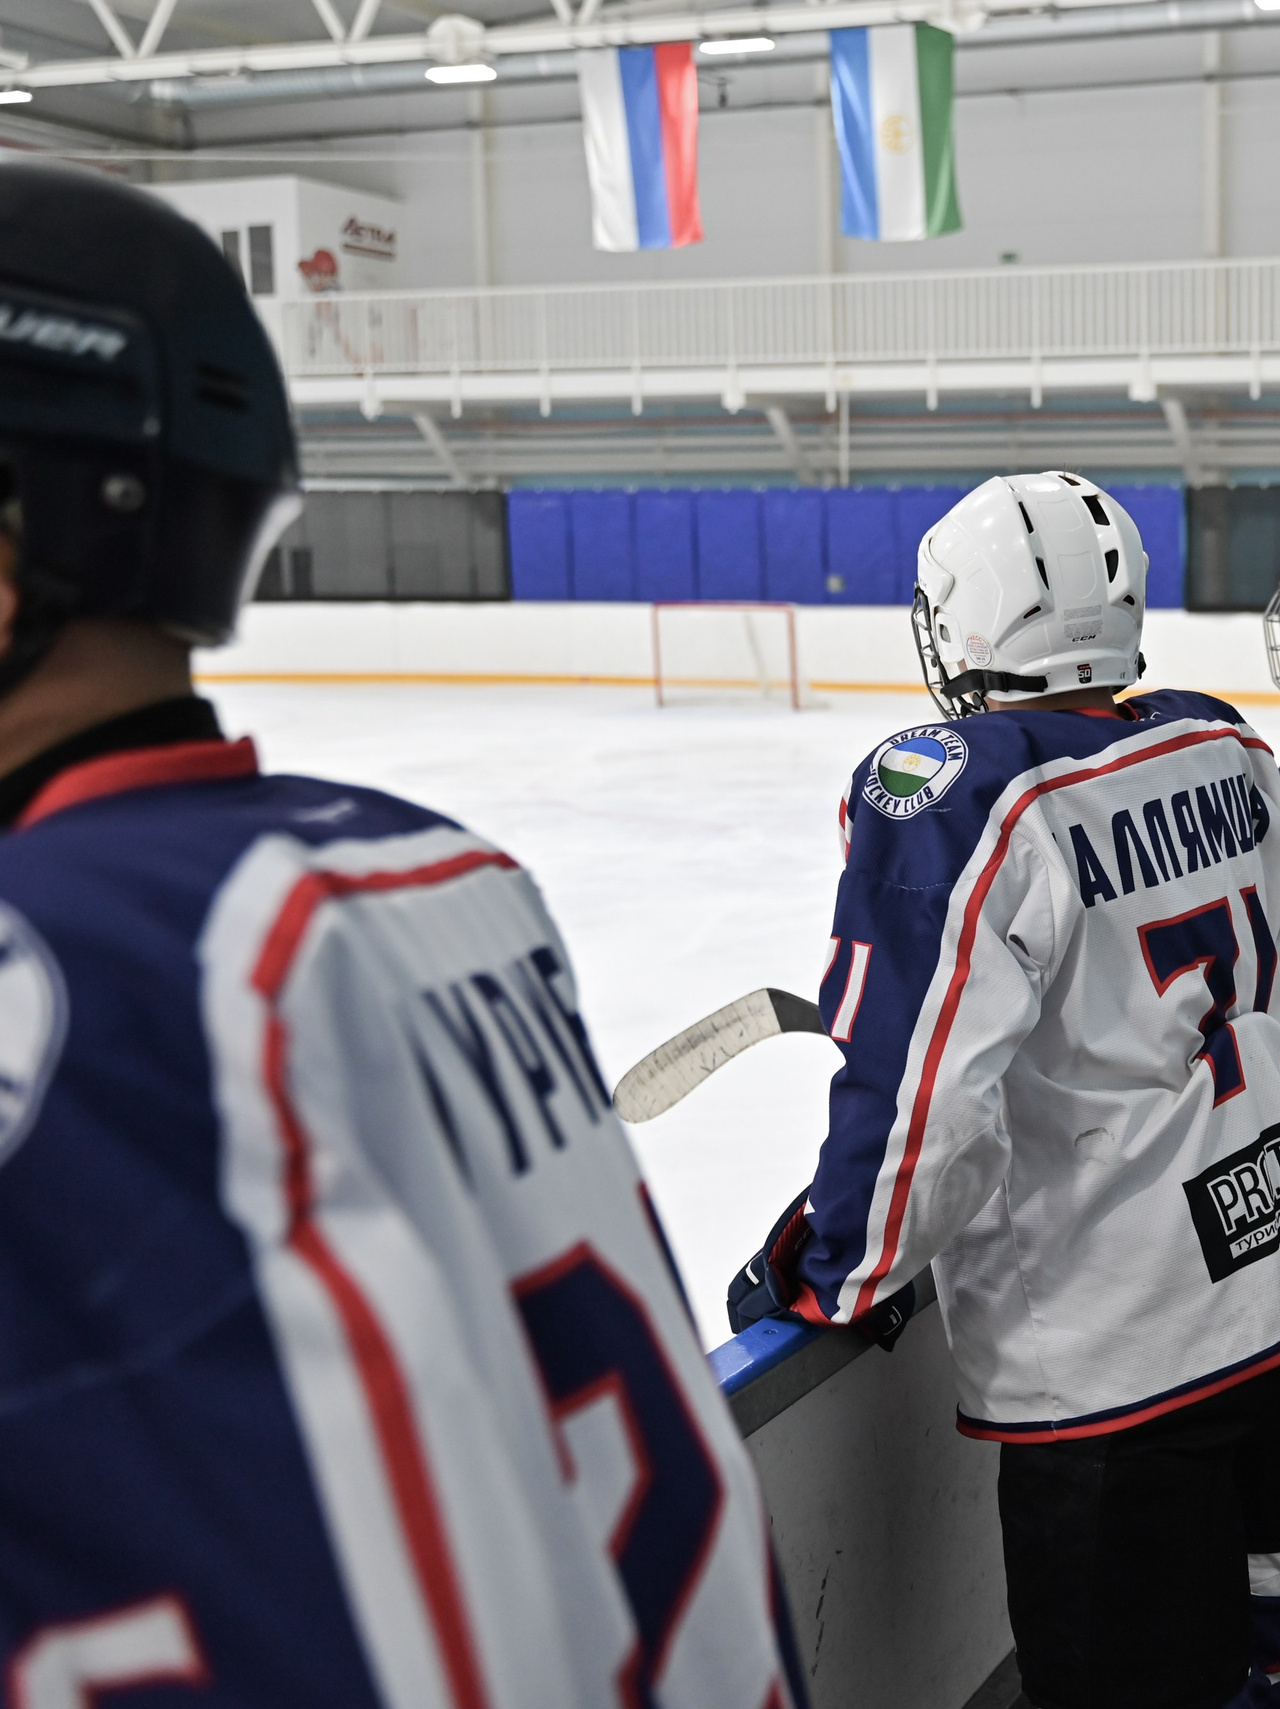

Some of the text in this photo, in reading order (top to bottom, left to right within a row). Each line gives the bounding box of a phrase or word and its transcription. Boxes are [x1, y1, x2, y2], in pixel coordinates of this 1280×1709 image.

[1072, 633, 1097, 643] CCM
[1078, 668, 1091, 679] 50
[889, 728, 964, 761] DREAM TEAM
[904, 785, 935, 813] CLUB
